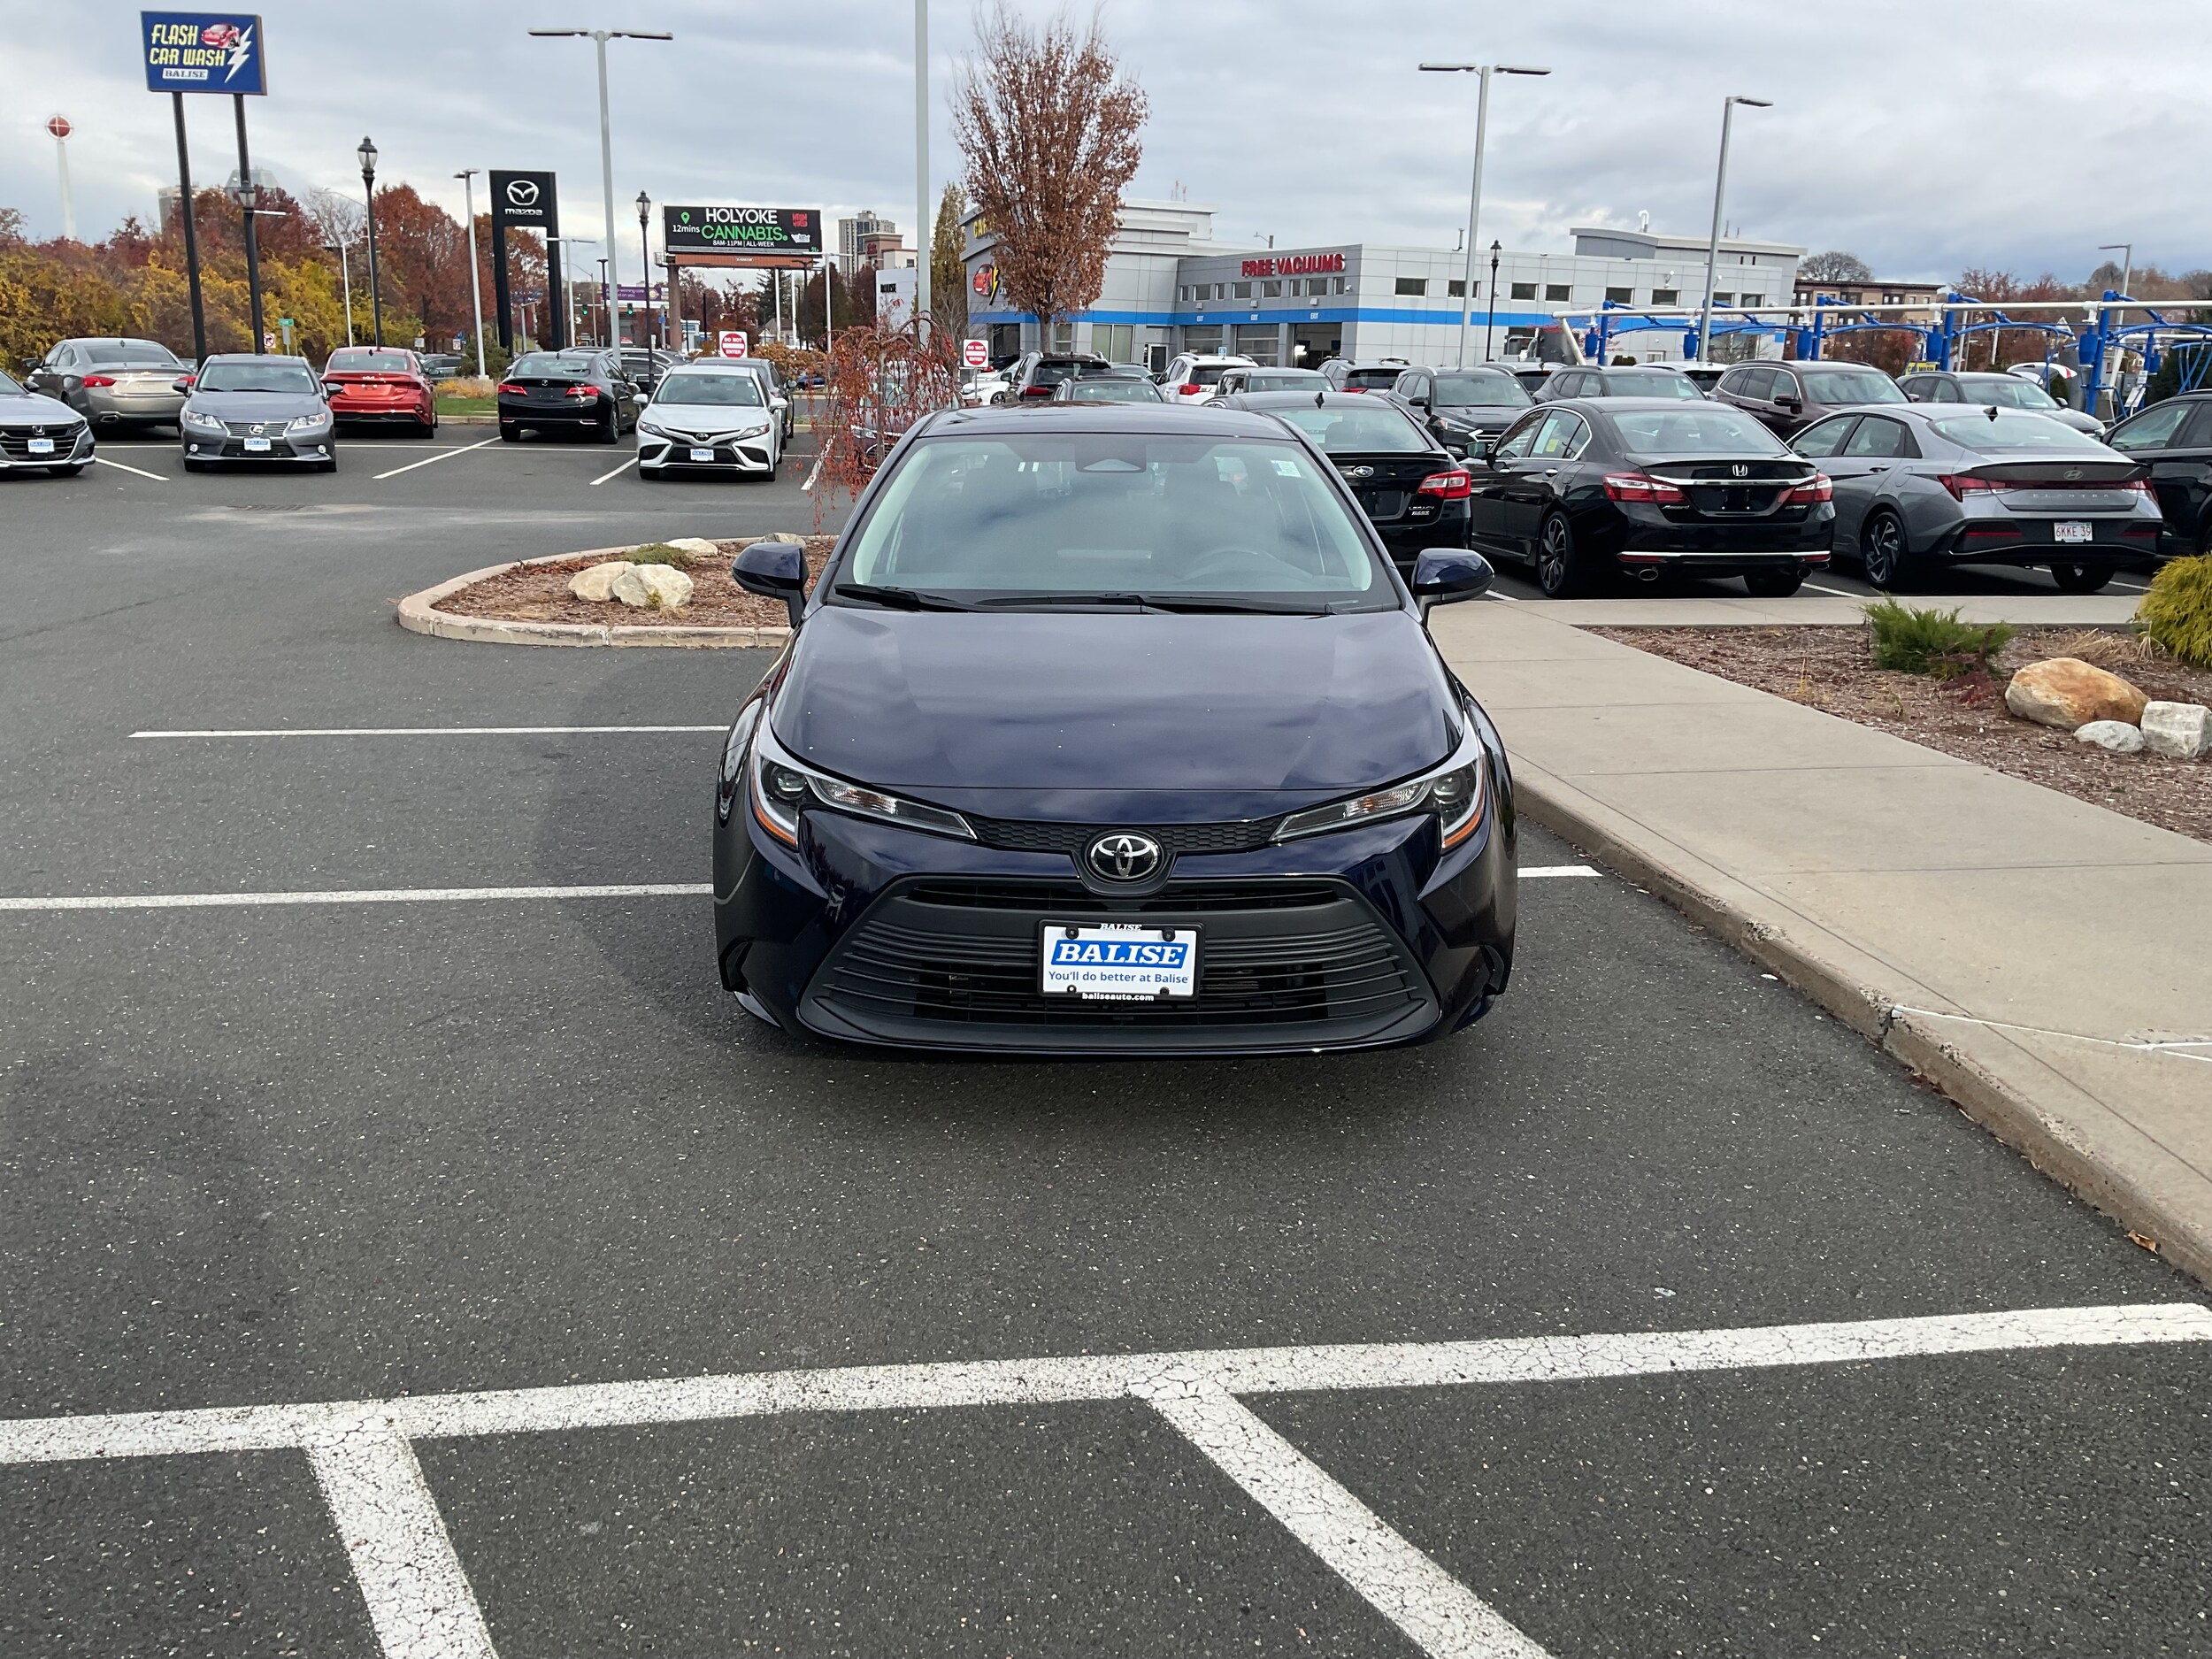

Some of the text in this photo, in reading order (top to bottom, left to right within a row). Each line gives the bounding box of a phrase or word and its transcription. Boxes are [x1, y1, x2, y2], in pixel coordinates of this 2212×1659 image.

[151, 23, 198, 46] FLASH
[149, 47, 226, 66] CAR WASH
[165, 69, 206, 79] BALISE
[705, 208, 778, 225] HOLYOKE
[672, 224, 701, 234] 12mins
[1241, 253, 1346, 277] FREE VACUUMS
[2055, 526, 2092, 537] 6KKE 39
[1056, 942, 1184, 965] BALISE
[1048, 971, 1188, 984] You'll do better at Balise
[1081, 992, 1155, 1002] baliseauto.com
